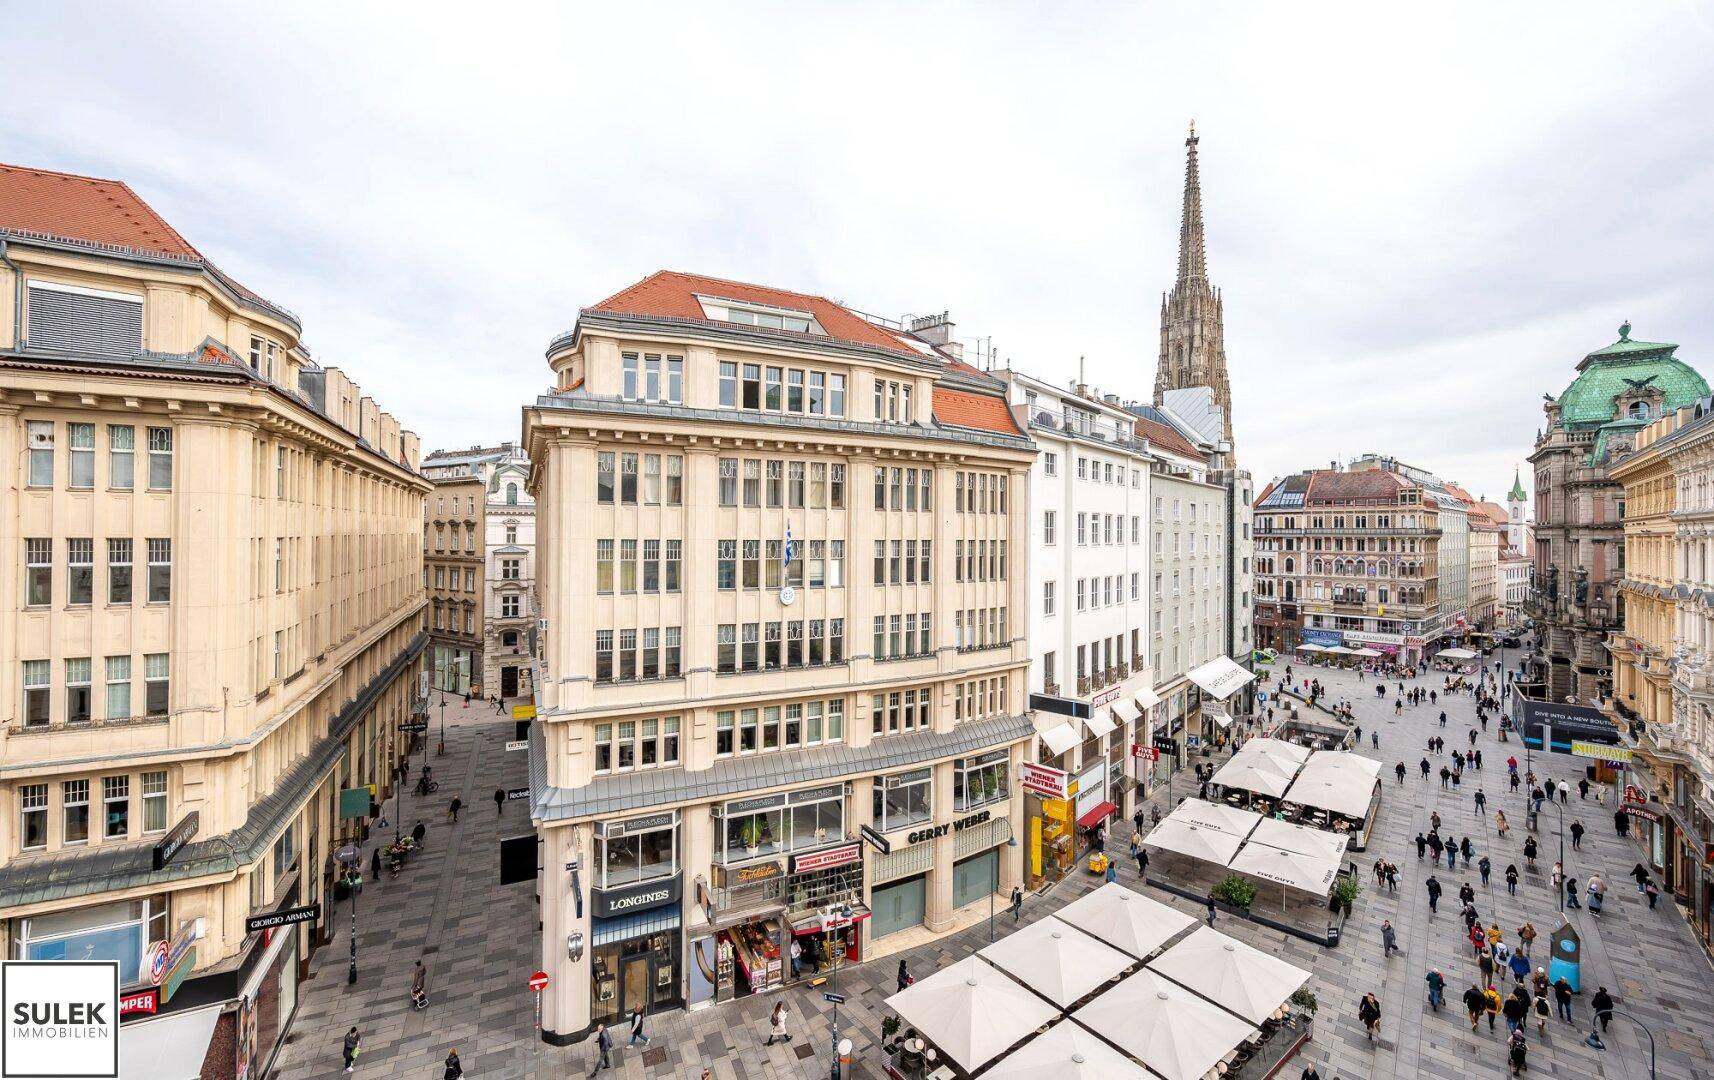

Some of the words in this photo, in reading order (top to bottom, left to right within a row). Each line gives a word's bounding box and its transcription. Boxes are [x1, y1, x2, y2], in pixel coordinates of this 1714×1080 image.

[1135, 751, 1155, 760] GUYS
[1030, 771, 1056, 783] WIENER
[908, 824, 950, 844] GERRY
[953, 810, 991, 832] WEBER
[799, 858, 822, 868] WIENER
[1274, 876, 1295, 885] GUYS
[610, 890, 669, 911] LONGINES
[251, 916, 283, 928] GIORGIO
[285, 910, 314, 923] ARMANI
